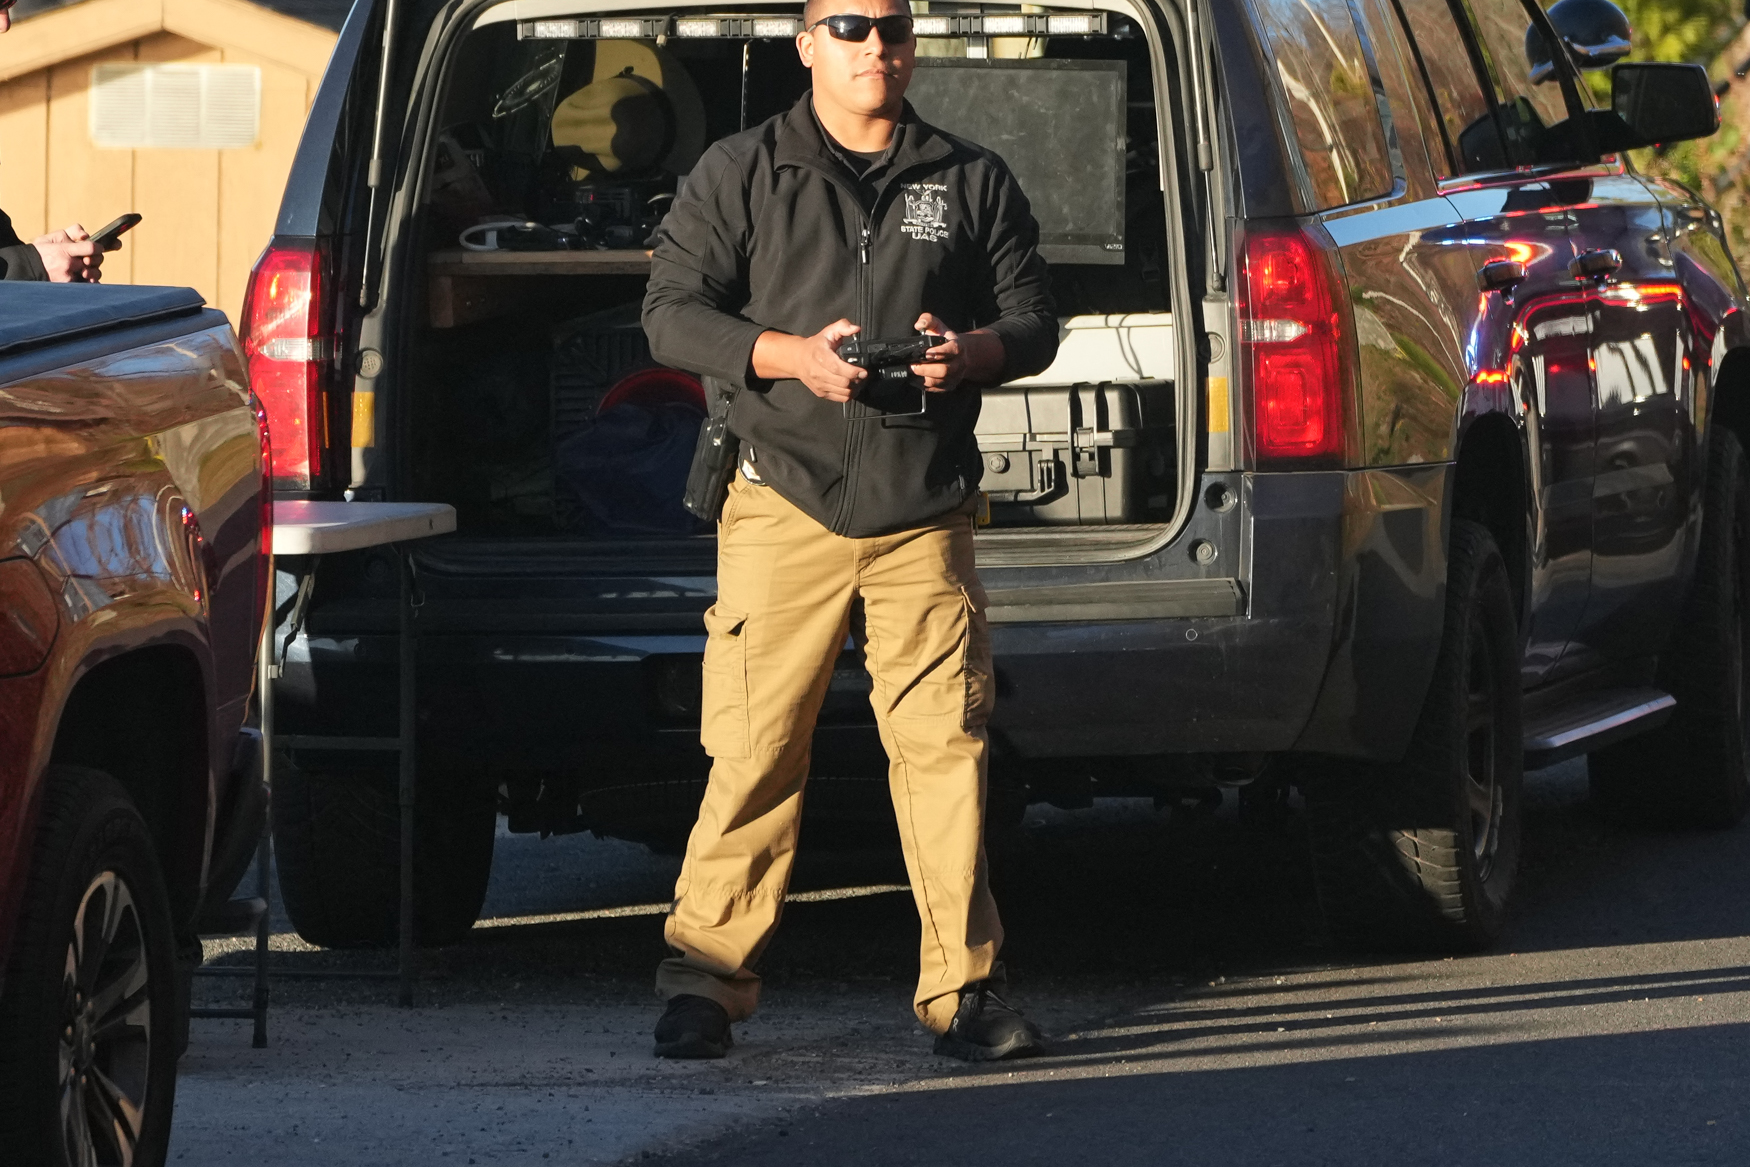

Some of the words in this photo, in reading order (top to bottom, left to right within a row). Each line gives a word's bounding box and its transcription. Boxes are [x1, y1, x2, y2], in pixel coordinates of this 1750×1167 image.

[922, 183, 948, 192] YORK
[900, 225, 924, 233] STATE
[924, 226, 949, 239] POLICE
[911, 232, 938, 242] UAS
